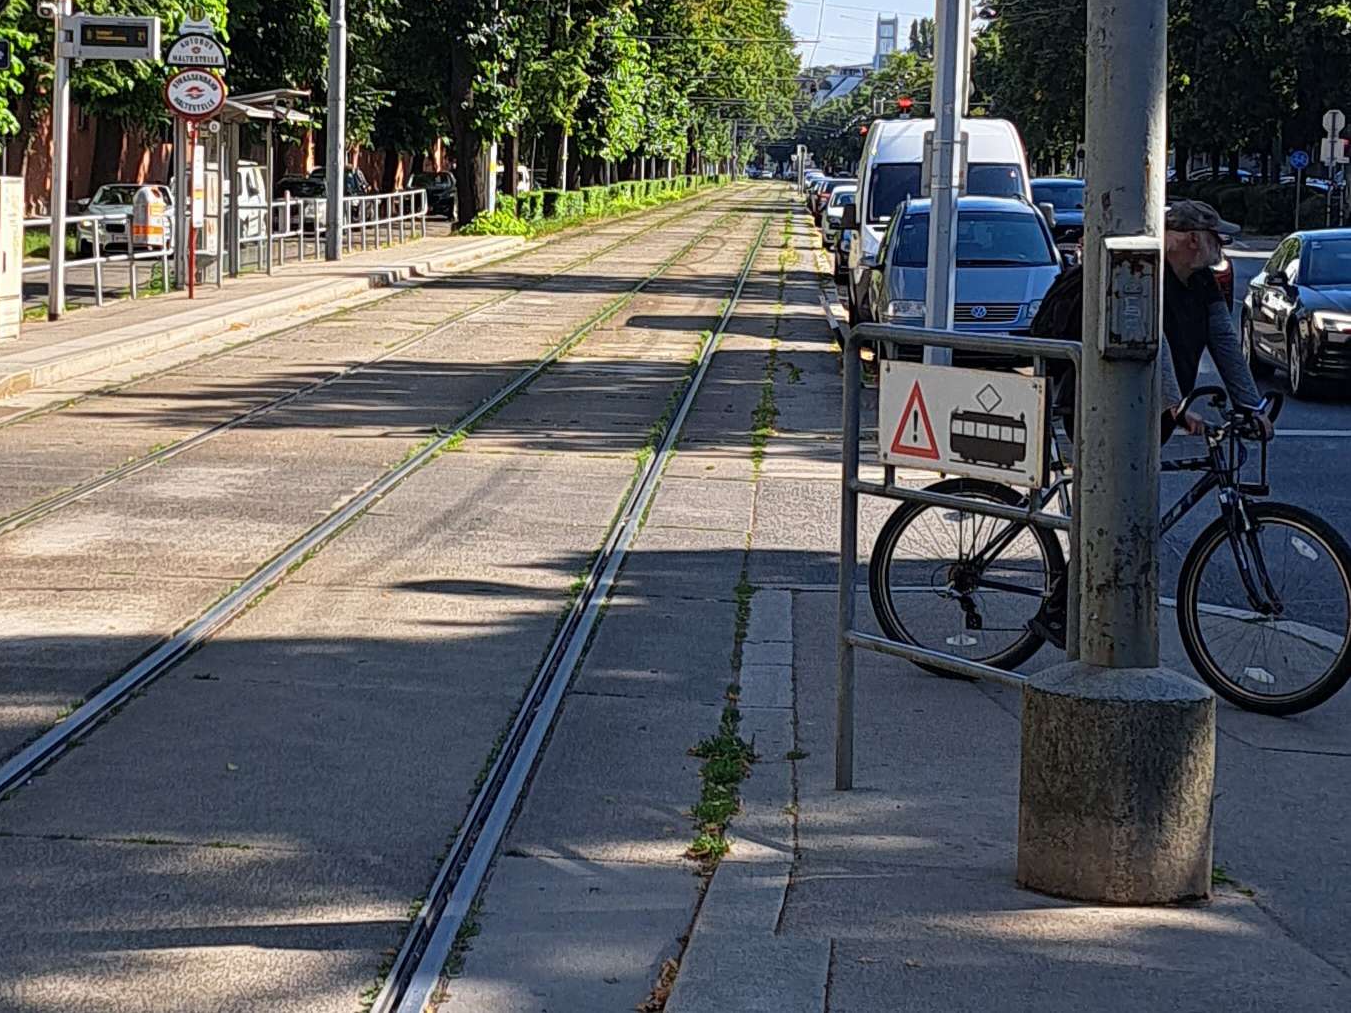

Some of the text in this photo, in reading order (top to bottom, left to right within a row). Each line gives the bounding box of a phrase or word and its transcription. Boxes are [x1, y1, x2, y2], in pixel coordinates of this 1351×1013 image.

[180, 37, 213, 50] AUTOBUS
[172, 55, 219, 63] HALTESTELLE
[173, 96, 216, 112] HALTESTELLE
